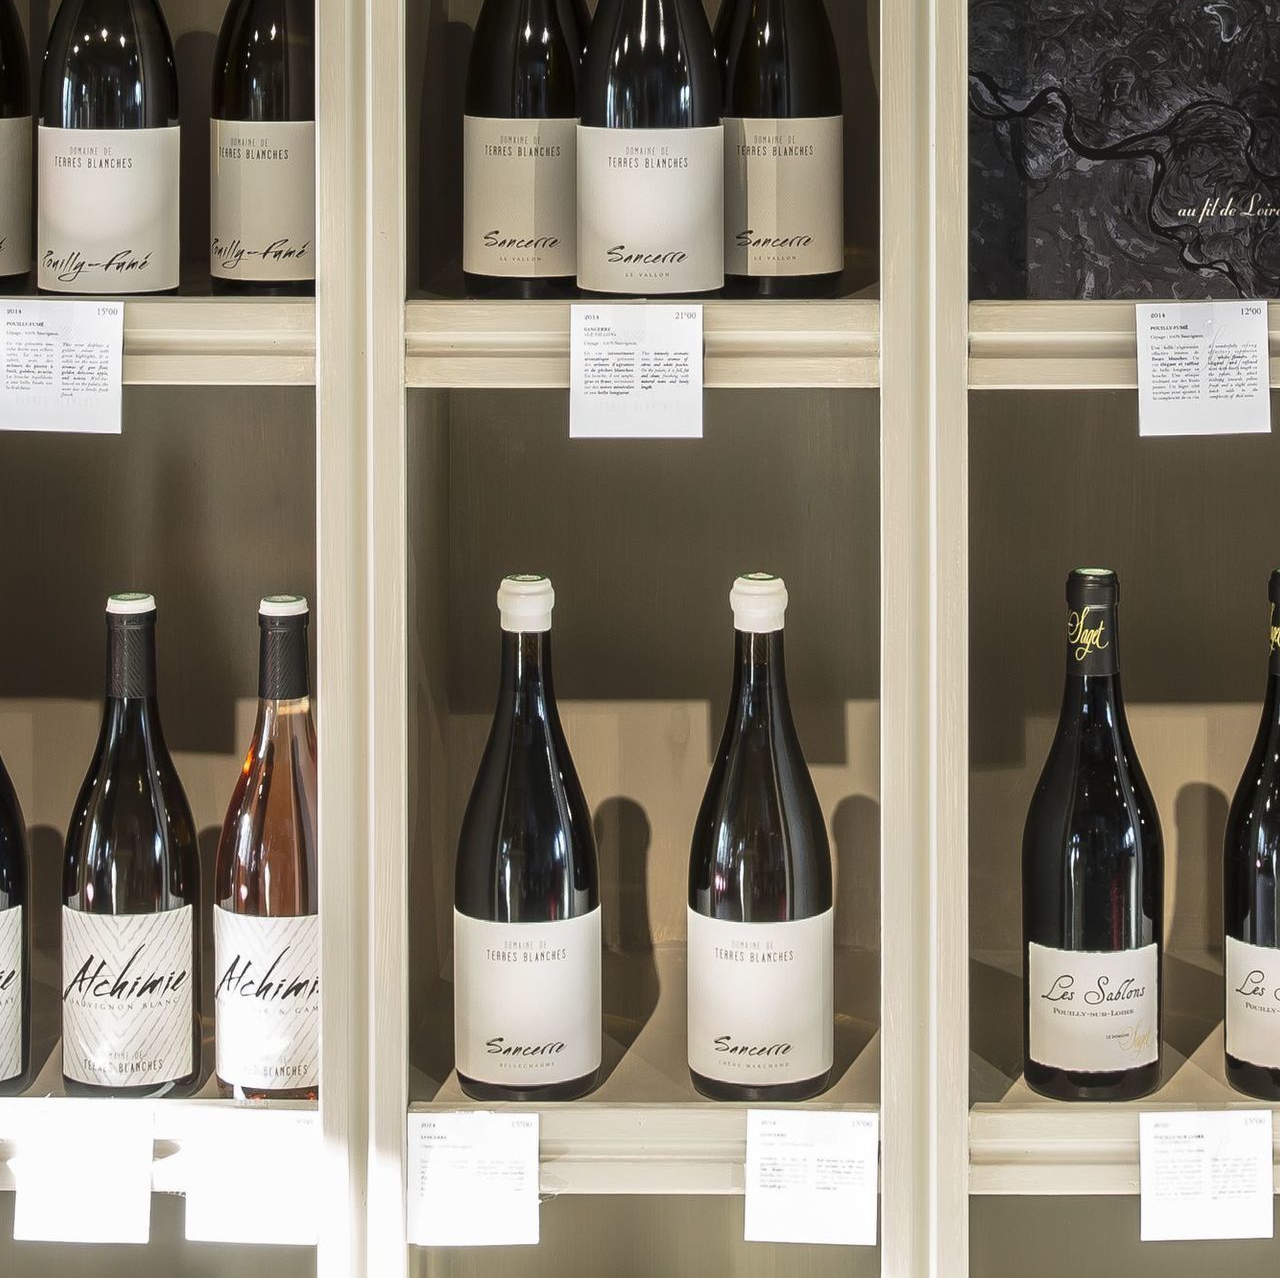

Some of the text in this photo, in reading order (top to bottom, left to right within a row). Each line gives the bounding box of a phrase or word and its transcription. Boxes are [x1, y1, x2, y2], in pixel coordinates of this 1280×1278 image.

[246, 148, 290, 160] BLANCHES
[485, 145, 562, 157] TERRES BLANCHES
[737, 144, 814, 156] TERRES BLANCHES
[55, 157, 133, 170] TERRES BLANCHES
[608, 156, 689, 169] TERRES BLANCHES
[1177, 207, 1196, 217] au
[1198, 198, 1218, 223] fil
[1219, 198, 1237, 217] de
[483, 230, 561, 249] Sancerre
[735, 230, 815, 249] Sancerre
[606, 245, 689, 264] Sancerre
[486, 948, 567, 963] TERRES BLANCHES
[714, 947, 794, 962] TERRES BLANCHES
[63, 944, 188, 1001] Alchimie
[1041, 974, 1146, 1005] Les Sablons
[1235, 969, 1265, 997] Les
[485, 1037, 568, 1056] Sancerre
[713, 1036, 792, 1056] Sancerre
